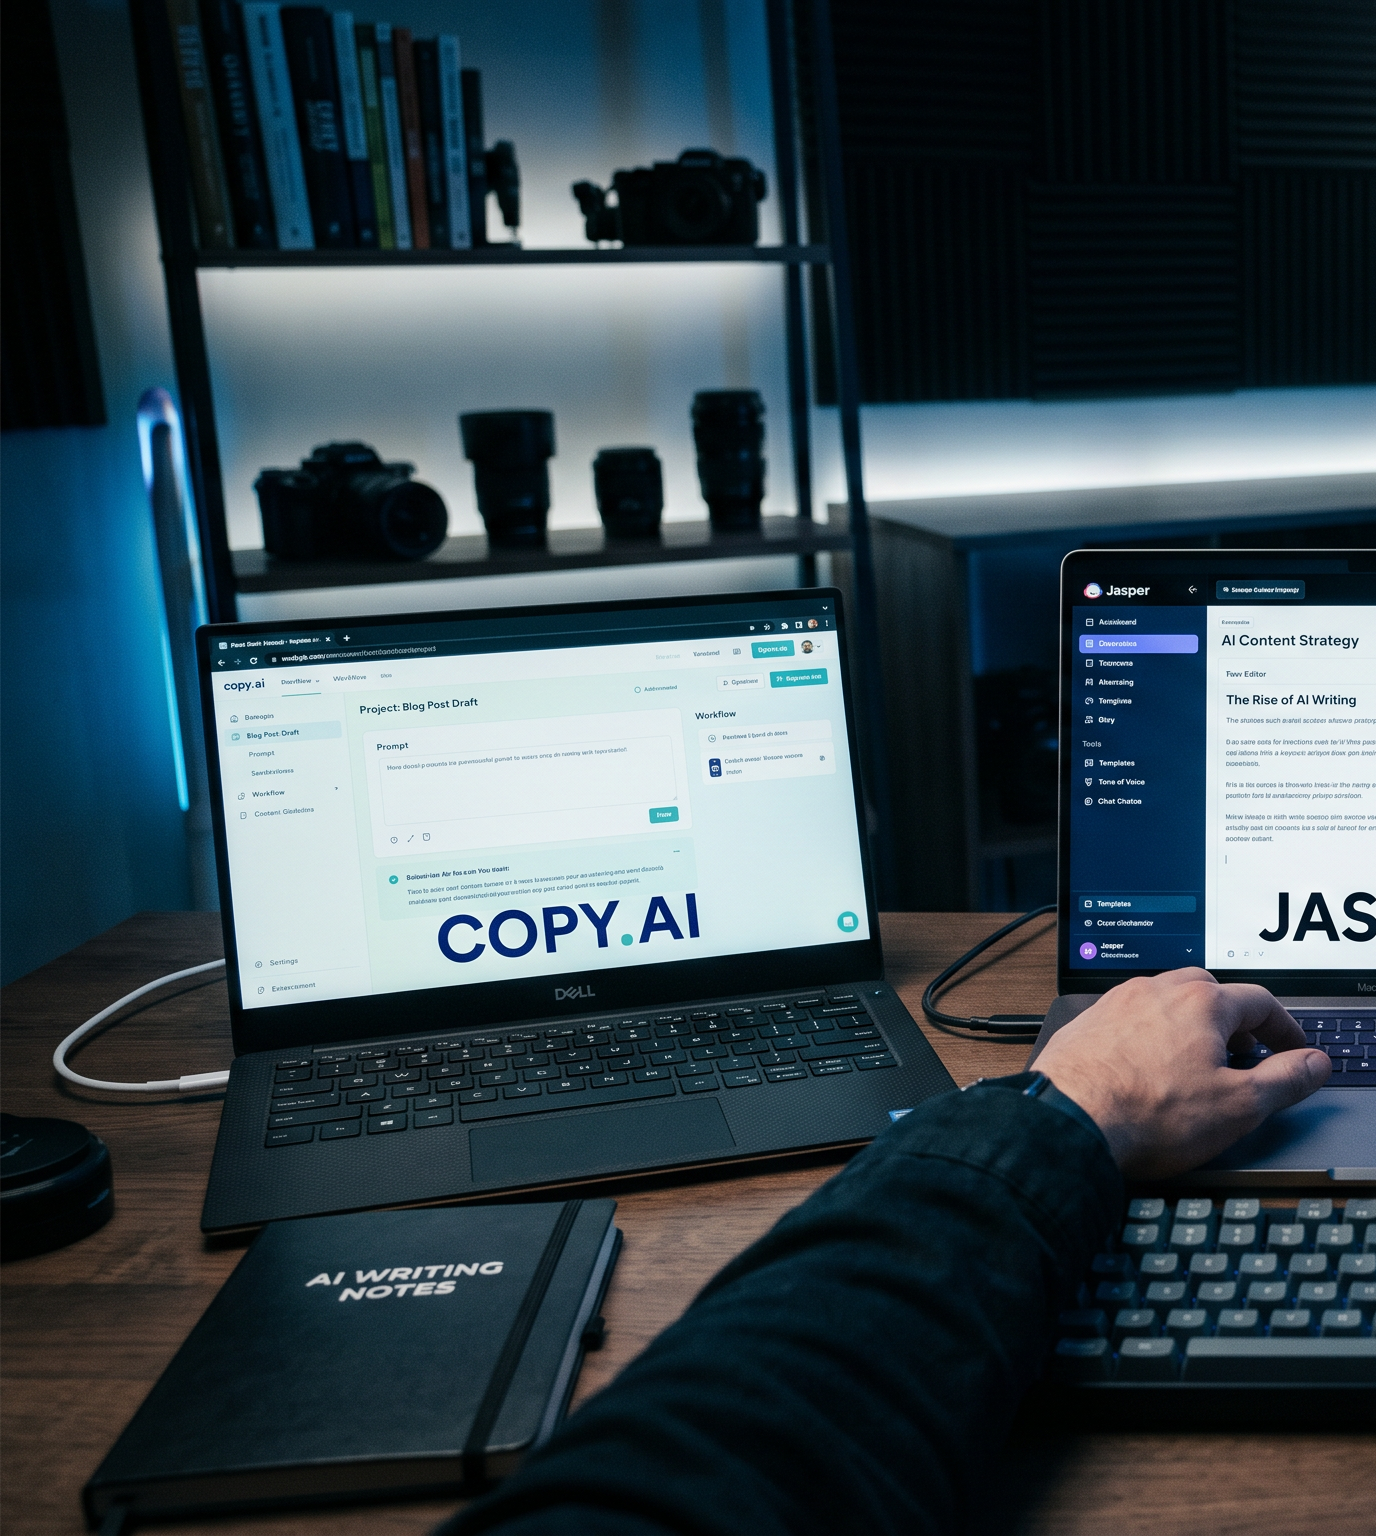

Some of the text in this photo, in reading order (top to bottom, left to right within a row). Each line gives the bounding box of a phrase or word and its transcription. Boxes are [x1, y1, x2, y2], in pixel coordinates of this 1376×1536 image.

[1106, 585, 1150, 598] Jasper
[1221, 634, 1359, 649] AI Content Strategy
[1244, 670, 1267, 678] Editor
[223, 678, 265, 692] copy.ai
[359, 697, 479, 715] Project: Blog Post Draft
[1226, 694, 1357, 708] The Rise of AI Writing
[694, 710, 736, 720] Workflow
[281, 729, 300, 737] Draft
[376, 741, 409, 752] Prompt
[1082, 740, 1102, 748] Tools
[1099, 759, 1136, 768] Templates
[1098, 778, 1146, 786] Tone of Voice
[437, 892, 701, 964] COPY.AI
[554, 985, 596, 1001] DELL
[305, 1261, 504, 1287] AI WRITING
[338, 1280, 457, 1302] NOTES
